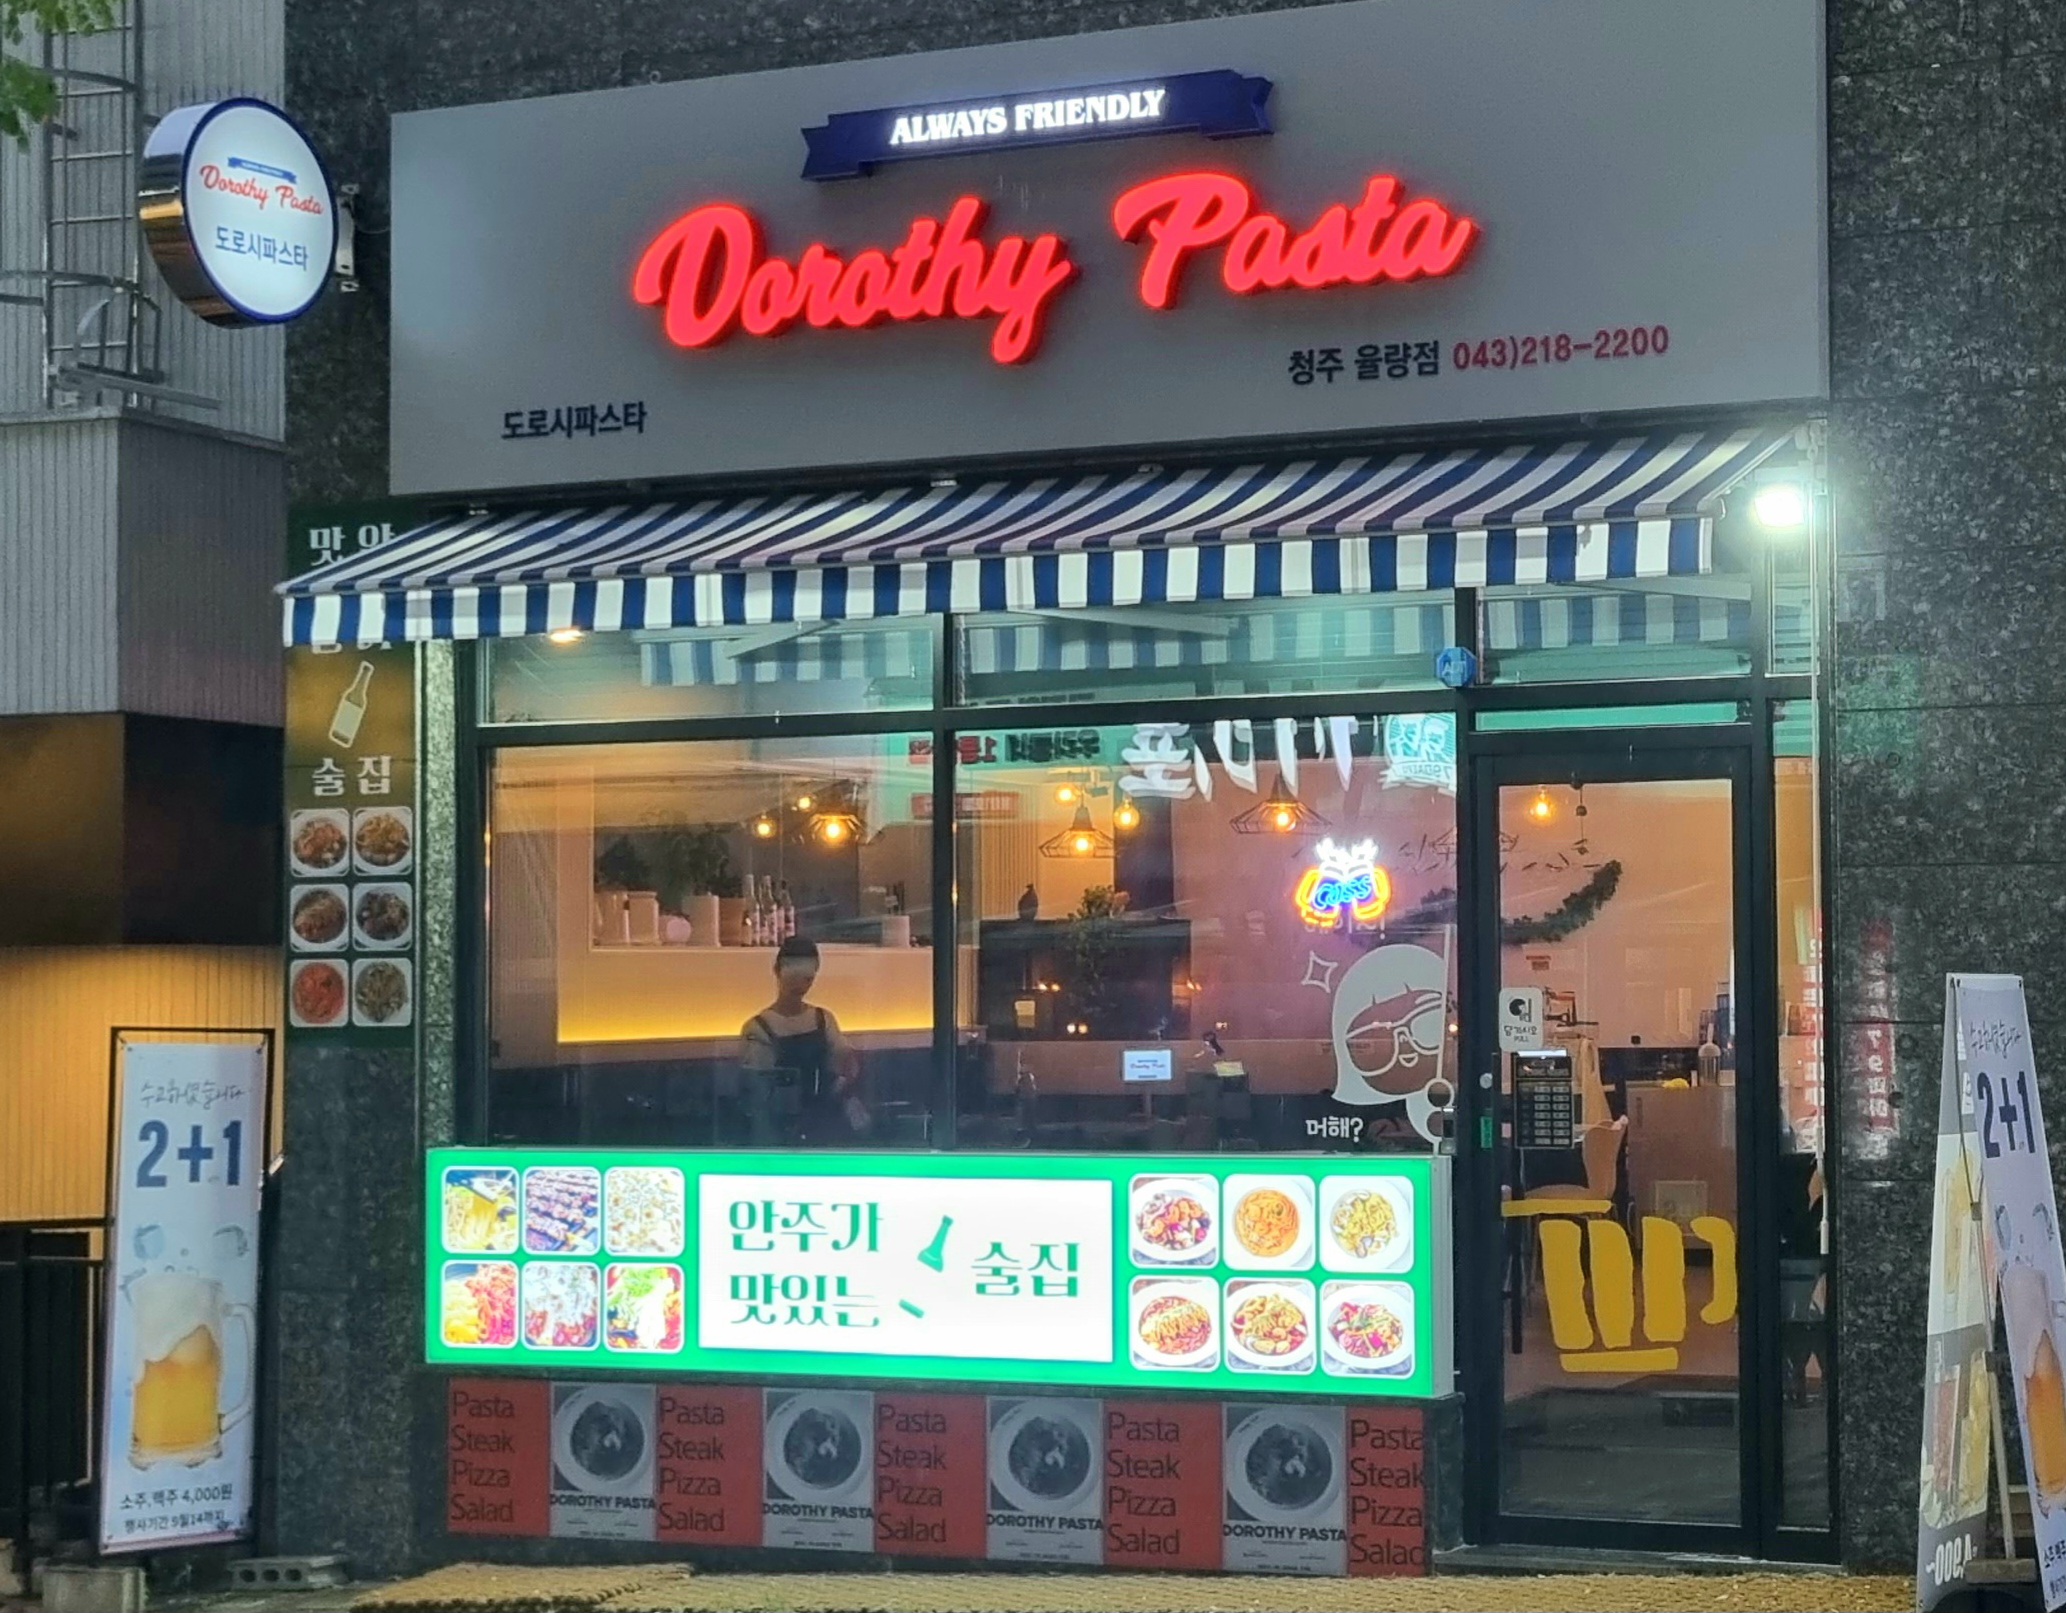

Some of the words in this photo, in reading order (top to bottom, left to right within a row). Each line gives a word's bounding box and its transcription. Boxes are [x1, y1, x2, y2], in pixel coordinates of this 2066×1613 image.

[889, 106, 1008, 145] ALWAYS
[1014, 89, 1166, 131] FRIENDLY
[199, 164, 269, 210] Dorothy
[275, 184, 324, 215] Pasta
[215, 225, 309, 271] 도로시파스타
[633, 196, 1074, 365] Dorothy
[1112, 172, 1476, 309] Pasta
[1288, 347, 1345, 386] 청주
[1354, 340, 1441, 381] 율량점
[1452, 325, 1670, 371] 043)218-2200
[501, 400, 648, 439] 도로시파스타
[1304, 1116, 1364, 1143] 머해?
[1977, 1070, 2036, 1159] 2+1
[136, 1119, 242, 1188] 2+1
[728, 1199, 884, 1252] 안주가
[970, 1241, 1081, 1298] 술집
[729, 1273, 880, 1327] 맛있는
[453, 1391, 515, 1419] Pasta
[660, 1397, 725, 1425] Pasta
[879, 1403, 947, 1434] Pasta
[451, 1425, 516, 1454] Steak
[1108, 1411, 1180, 1442] Pasta
[1351, 1419, 1423, 1450] Pasta
[659, 1432, 725, 1461] Steak
[877, 1441, 947, 1471] Steak
[452, 1460, 511, 1488] Pizza
[1108, 1450, 1181, 1480] Steak
[1350, 1457, 1424, 1488] Steak
[660, 1468, 722, 1496] Pizza
[879, 1477, 943, 1507] Pizza
[451, 1493, 514, 1523] Salad
[550, 1493, 613, 1508] DOROTHY
[614, 1496, 656, 1510] PASTA
[762, 1503, 828, 1518] DOROTHY
[830, 1505, 874, 1520] PASTA
[1108, 1486, 1177, 1517] Pizza
[1352, 1496, 1423, 1527] Pizza
[658, 1503, 725, 1532] Salad
[877, 1513, 947, 1543] Salad
[986, 1513, 1056, 1528] DOROTHY
[1058, 1516, 1104, 1531] PASTA
[1107, 1523, 1180, 1555] Salad
[1222, 1524, 1297, 1540] DOROTHY
[1300, 1527, 1347, 1543] PASTA
